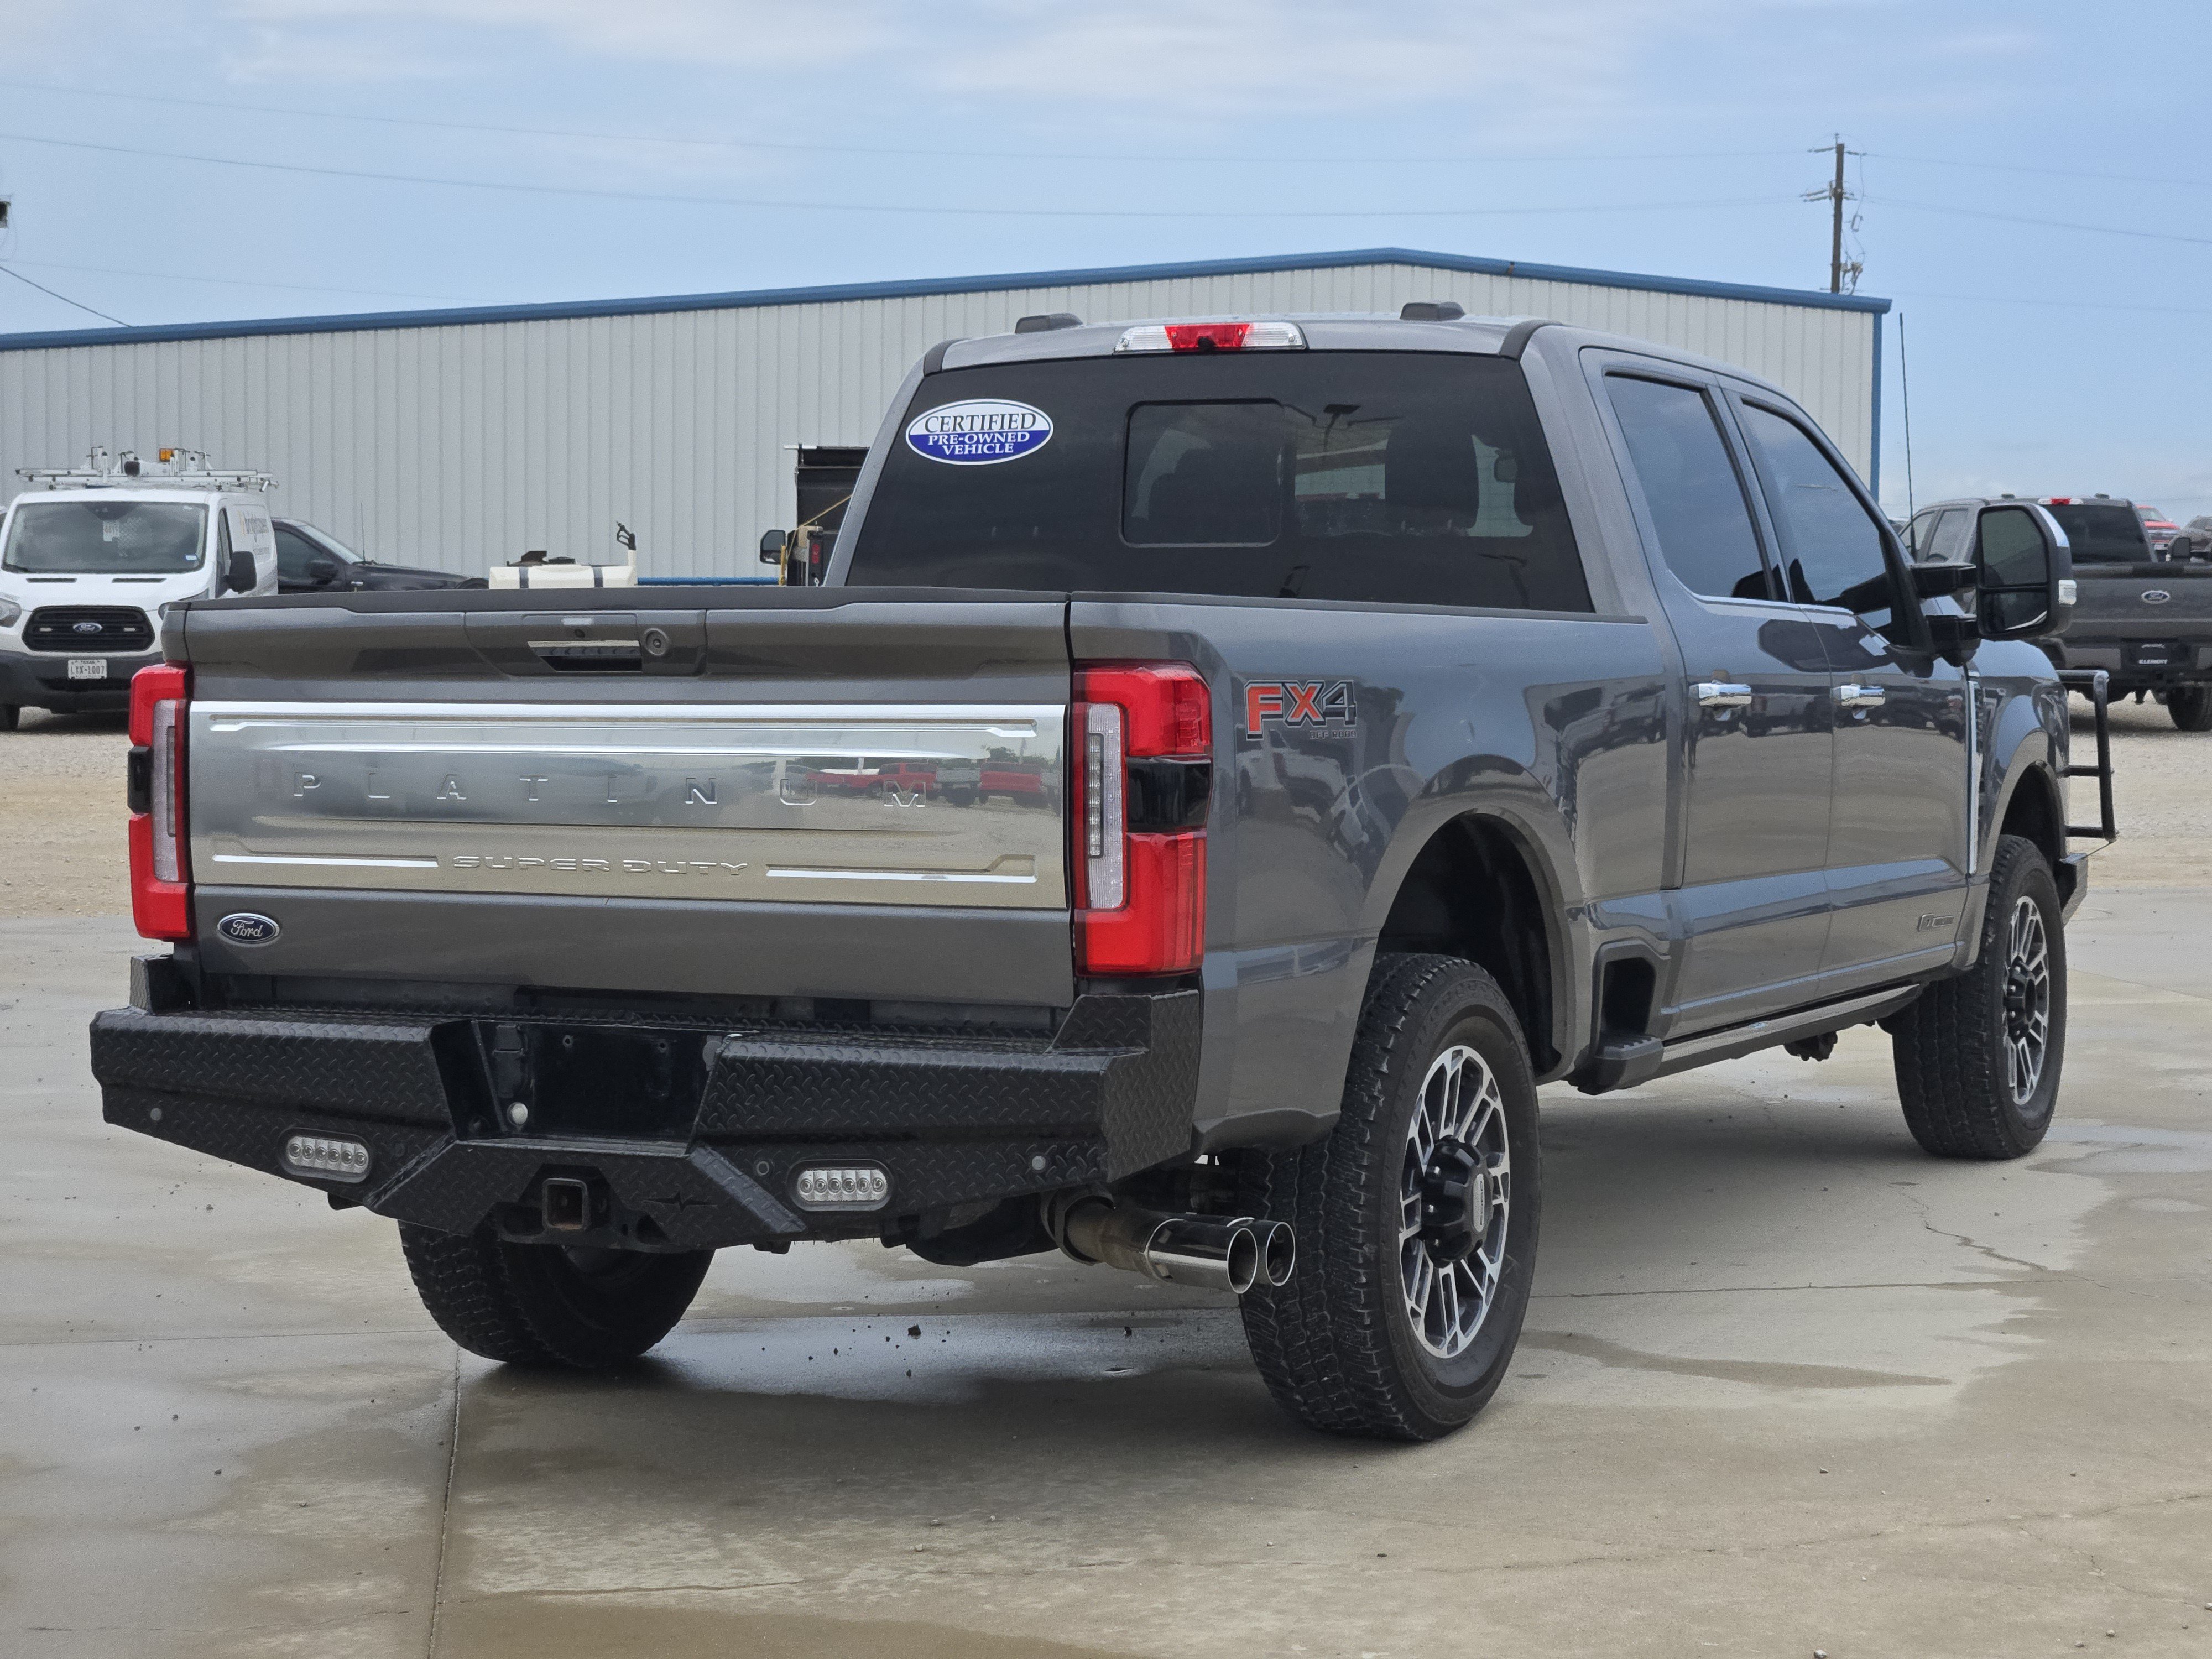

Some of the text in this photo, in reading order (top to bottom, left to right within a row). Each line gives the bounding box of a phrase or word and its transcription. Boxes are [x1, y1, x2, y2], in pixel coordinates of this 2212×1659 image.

[925, 413, 1036, 434] CERTIFIED
[928, 431, 1030, 445] PRE-OWNED
[942, 443, 1014, 455] VEHICLE
[1244, 680, 1357, 741] FX4
[1310, 729, 1357, 740] OFF ROAD
[294, 772, 926, 807] PLATINUM
[453, 856, 748, 875] SUPER DUTY
[230, 919, 263, 937] Ford
